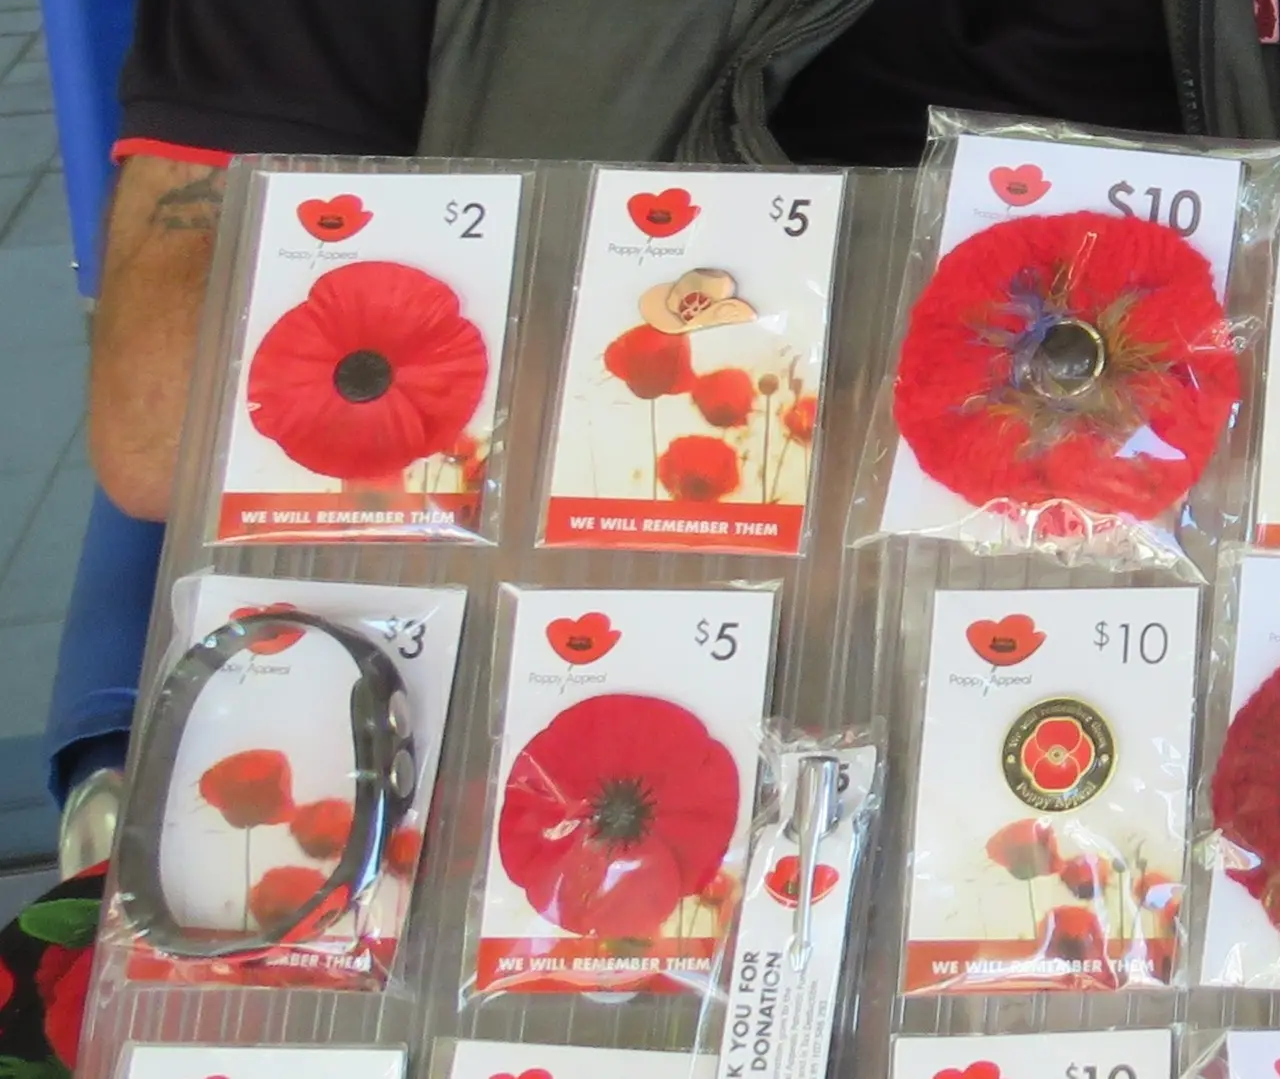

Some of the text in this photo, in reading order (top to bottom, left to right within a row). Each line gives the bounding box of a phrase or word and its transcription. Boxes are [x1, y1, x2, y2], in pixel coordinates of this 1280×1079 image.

[443, 200, 486, 239] $2
[769, 195, 812, 238] $5
[1107, 180, 1203, 238] $10
[278, 248, 359, 263] Poppy Appeal
[607, 242, 686, 258] Poppy Appeal
[241, 510, 455, 525] WE WILL REMEMBER THEM
[570, 516, 778, 537] WE WILL REMEMBER THEM
[383, 615, 426, 660] $3
[694, 619, 739, 661] $5
[1093, 621, 1168, 665] $10
[528, 671, 607, 685] Poppy Appeal
[949, 674, 1032, 688] Poppy Appeal
[498, 956, 712, 973] WE WILL REMEMBER THEM
[932, 959, 962, 974] WE
[966, 960, 1005, 974] WILL
[729, 951, 761, 1053] YOU FOR
[750, 951, 783, 1071] DONATION
